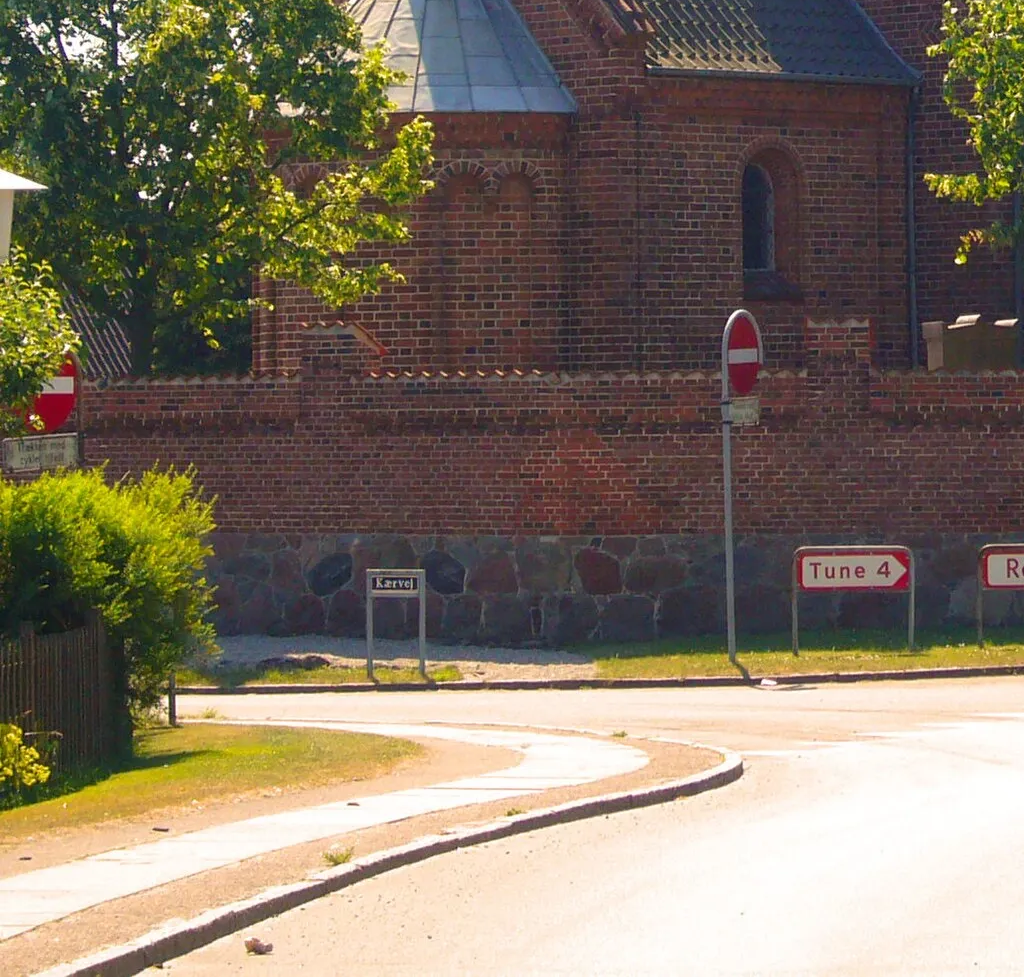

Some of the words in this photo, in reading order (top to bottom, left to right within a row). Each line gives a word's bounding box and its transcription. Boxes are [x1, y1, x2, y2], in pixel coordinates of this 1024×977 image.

[809, 562, 866, 579] Tune
[876, 561, 891, 578] 4
[376, 577, 414, 590] Kærvej
